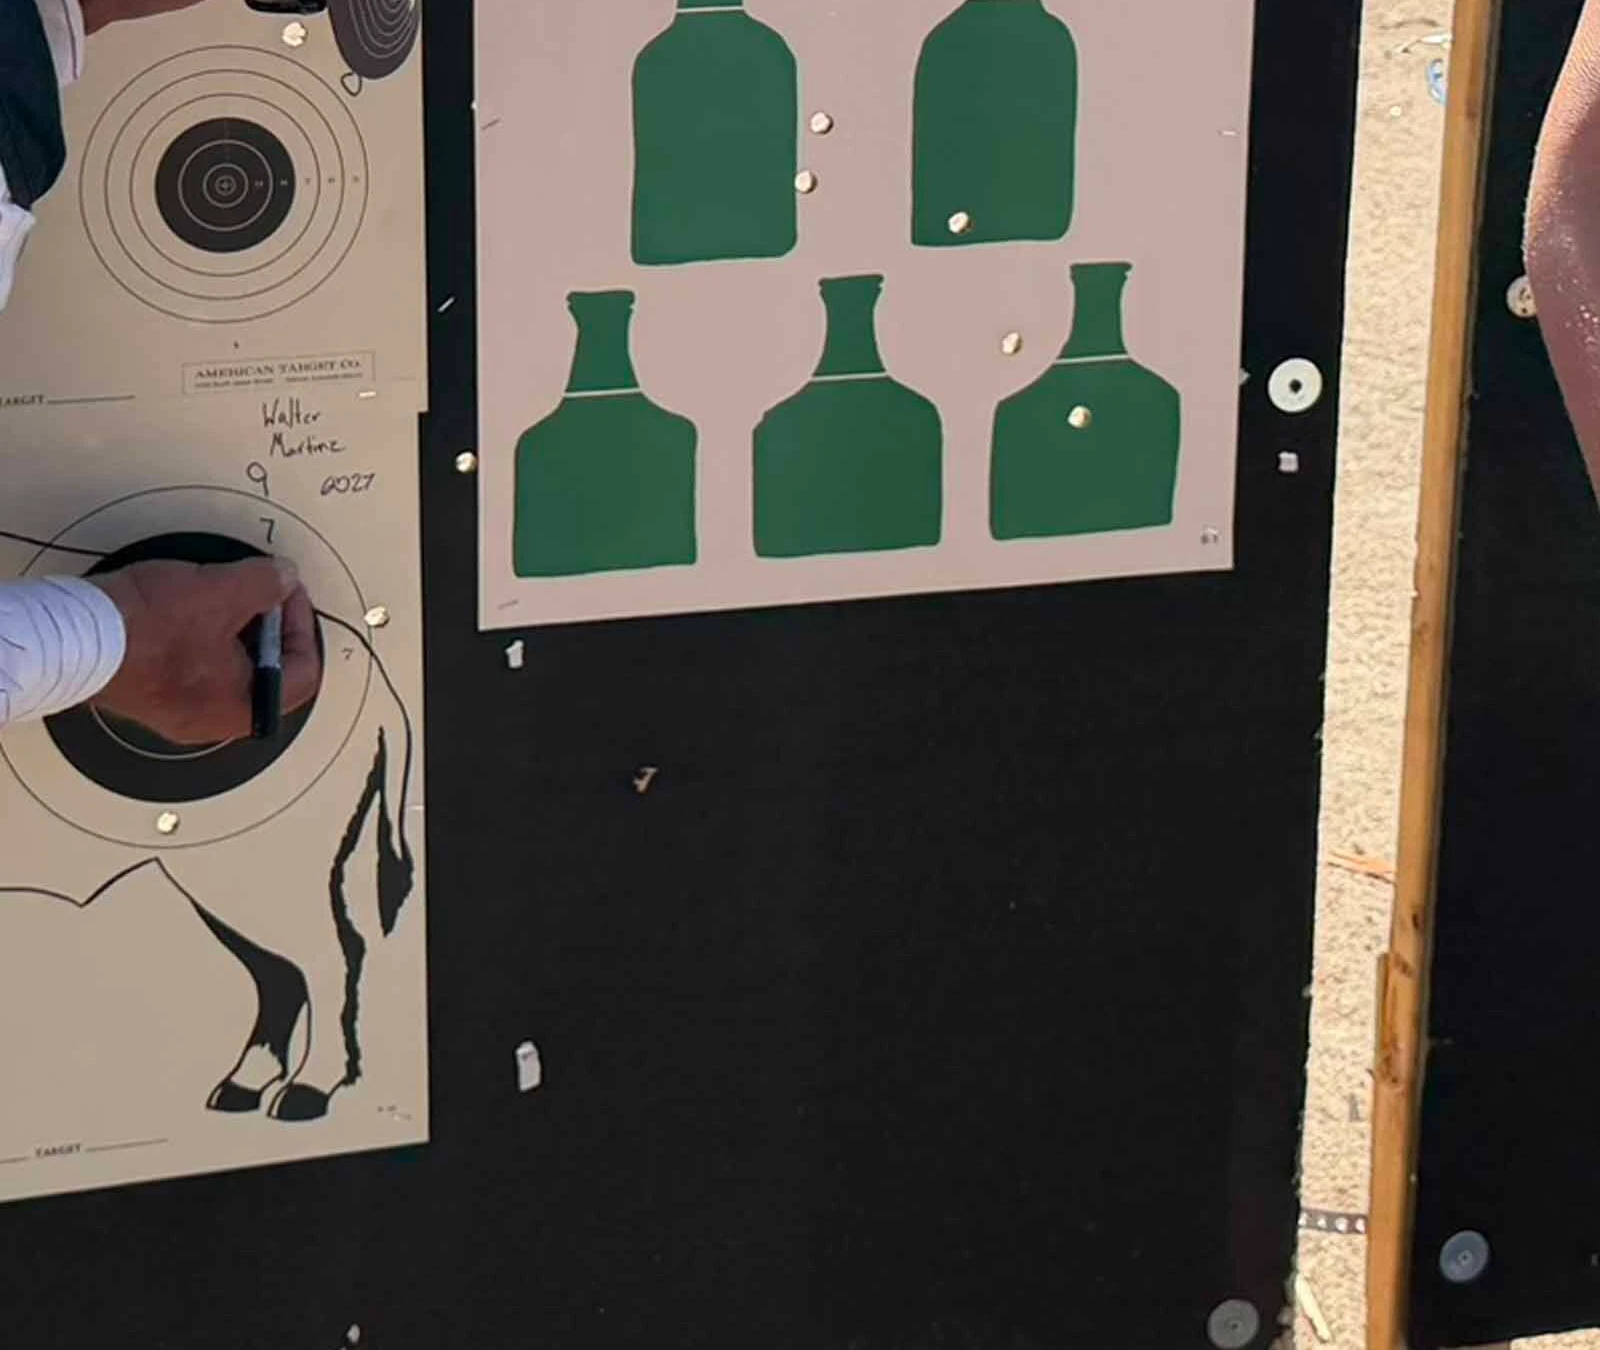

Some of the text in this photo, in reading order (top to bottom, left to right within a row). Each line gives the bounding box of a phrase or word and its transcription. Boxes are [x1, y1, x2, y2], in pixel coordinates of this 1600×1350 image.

[195, 363, 275, 379] AMERICAN
[280, 359, 335, 375] TARGET
[262, 397, 322, 429] Walter
[246, 462, 269, 497] 9
[260, 517, 274, 545] 7
[35, 1143, 82, 1159] TARGET
